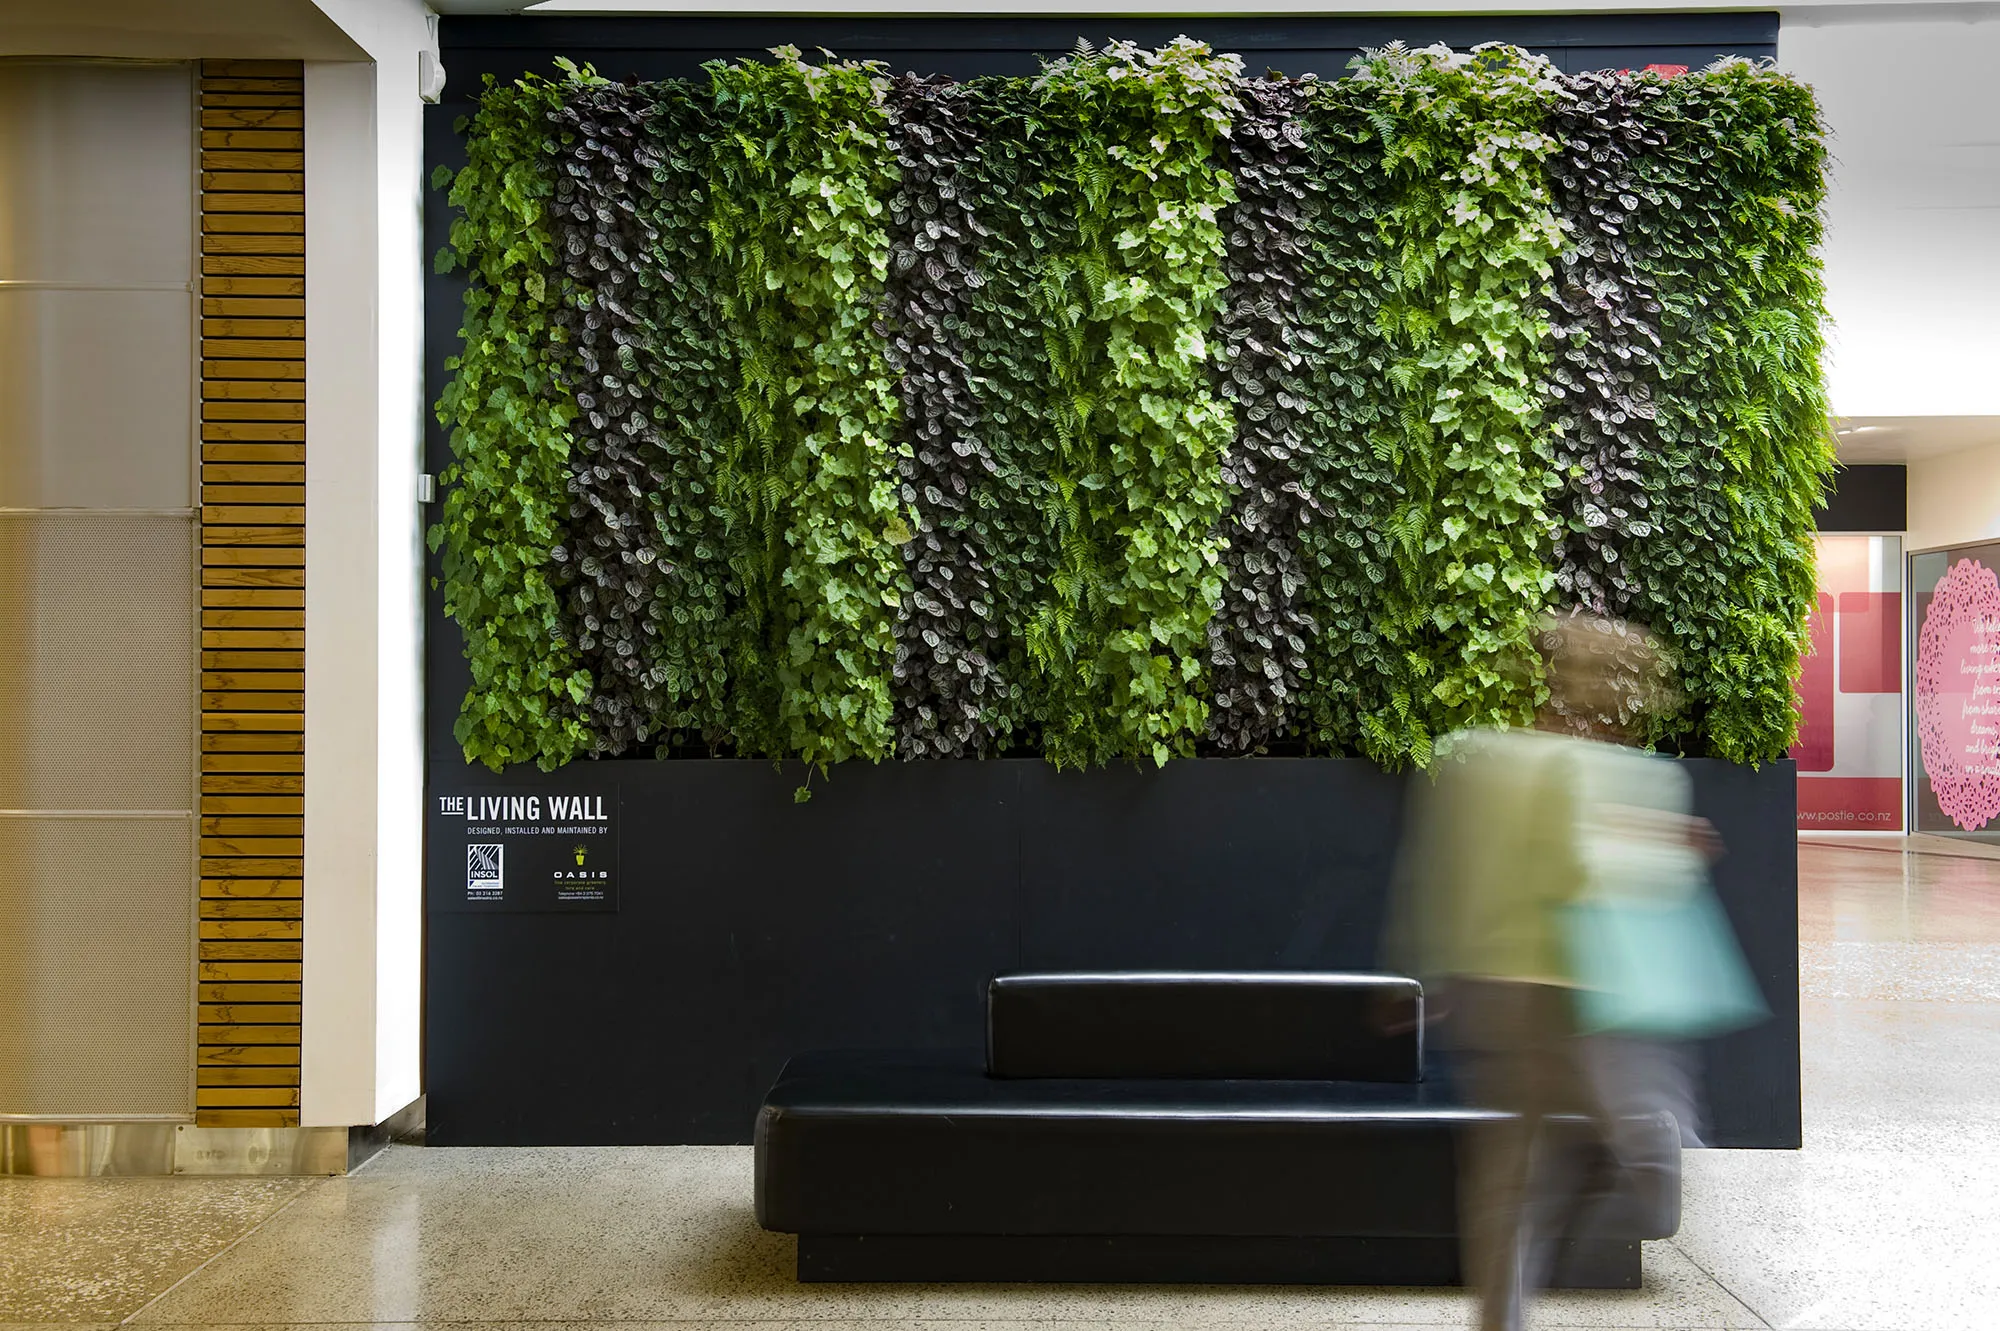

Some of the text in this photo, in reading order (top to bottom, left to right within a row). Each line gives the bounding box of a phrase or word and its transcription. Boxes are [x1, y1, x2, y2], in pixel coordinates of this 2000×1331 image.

[439, 796, 608, 821] THE LIVING WALL
[1796, 810, 1892, 822] ww.postie.co.nz
[467, 826, 608, 836] DESIGNED, INSTALLED AND MAINTAINED BY
[471, 870, 498, 878] INSOL
